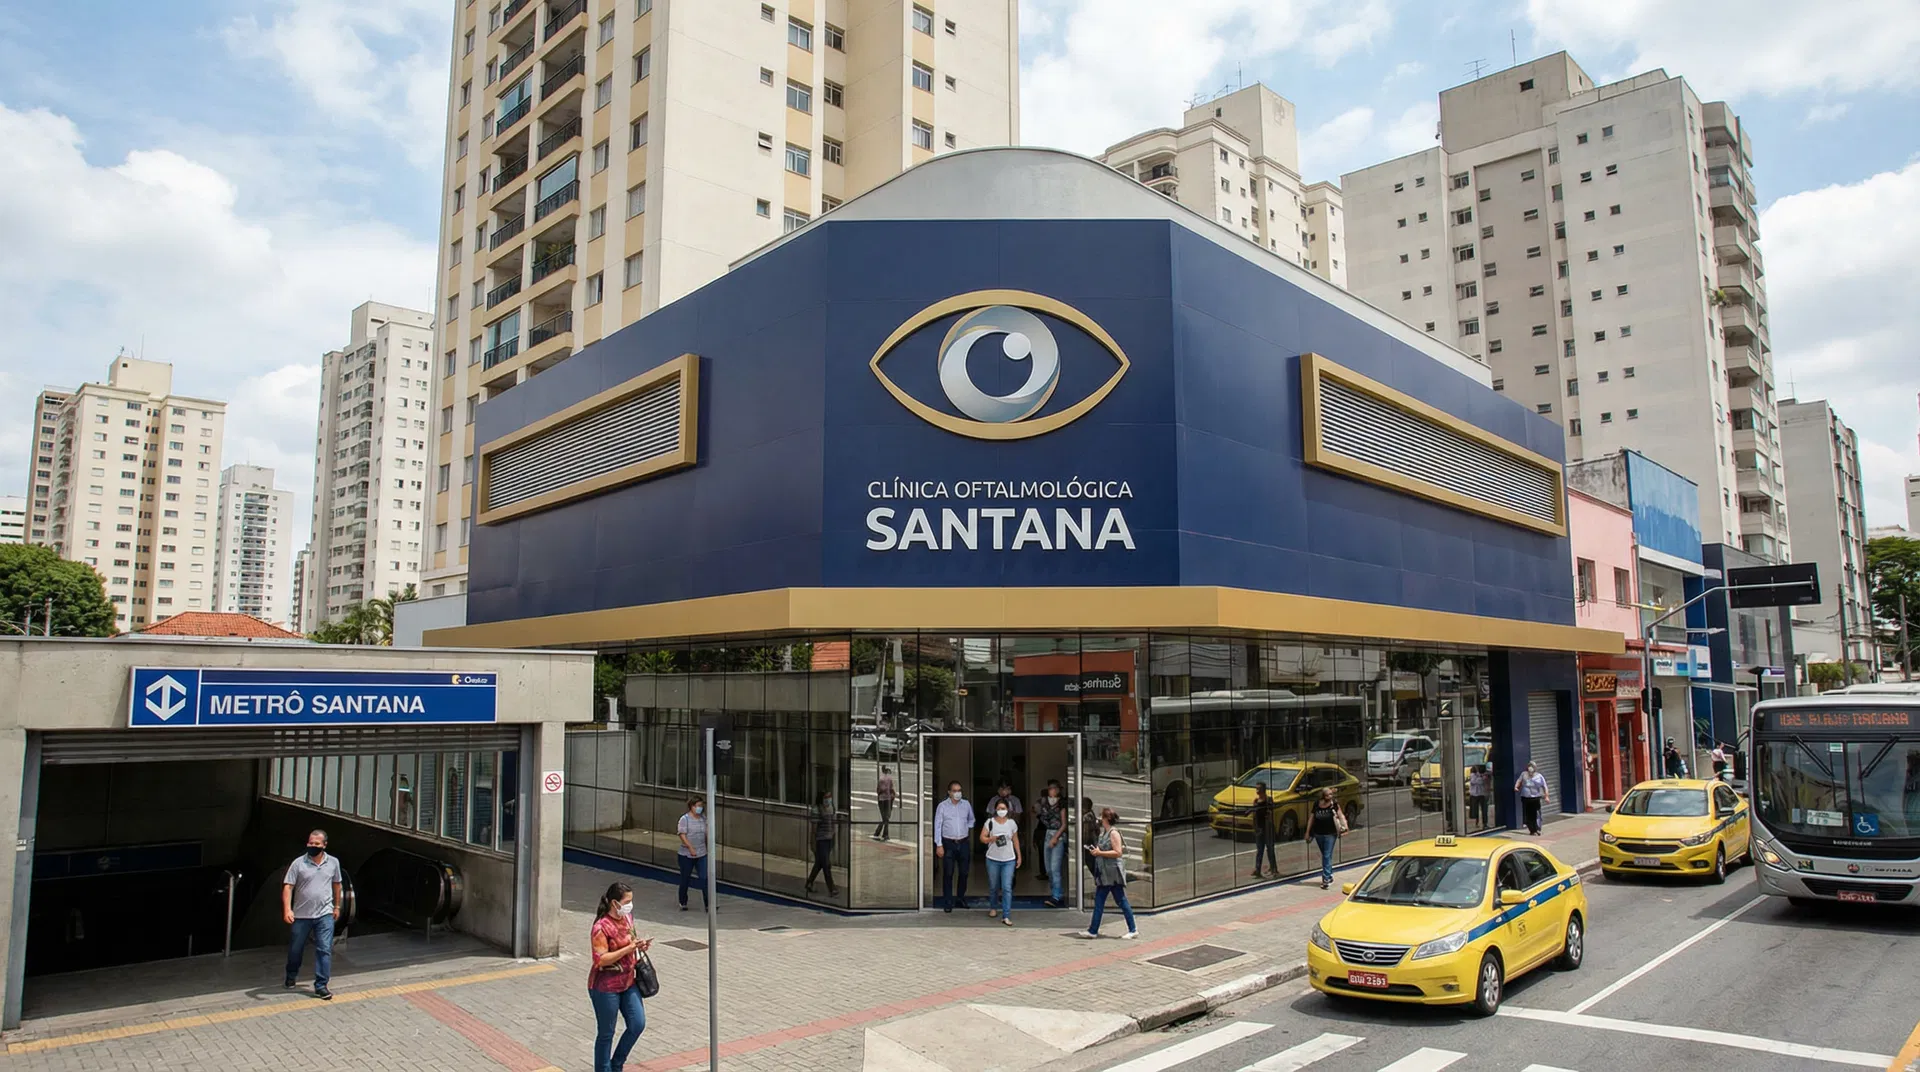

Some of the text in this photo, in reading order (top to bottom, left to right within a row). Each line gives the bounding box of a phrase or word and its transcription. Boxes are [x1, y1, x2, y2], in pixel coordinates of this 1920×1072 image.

[867, 476, 1134, 499] CLÍNICA OFTALMOLÓGICA
[865, 507, 1137, 551] SANTANA
[209, 690, 426, 716] METRÔ SANTANA
